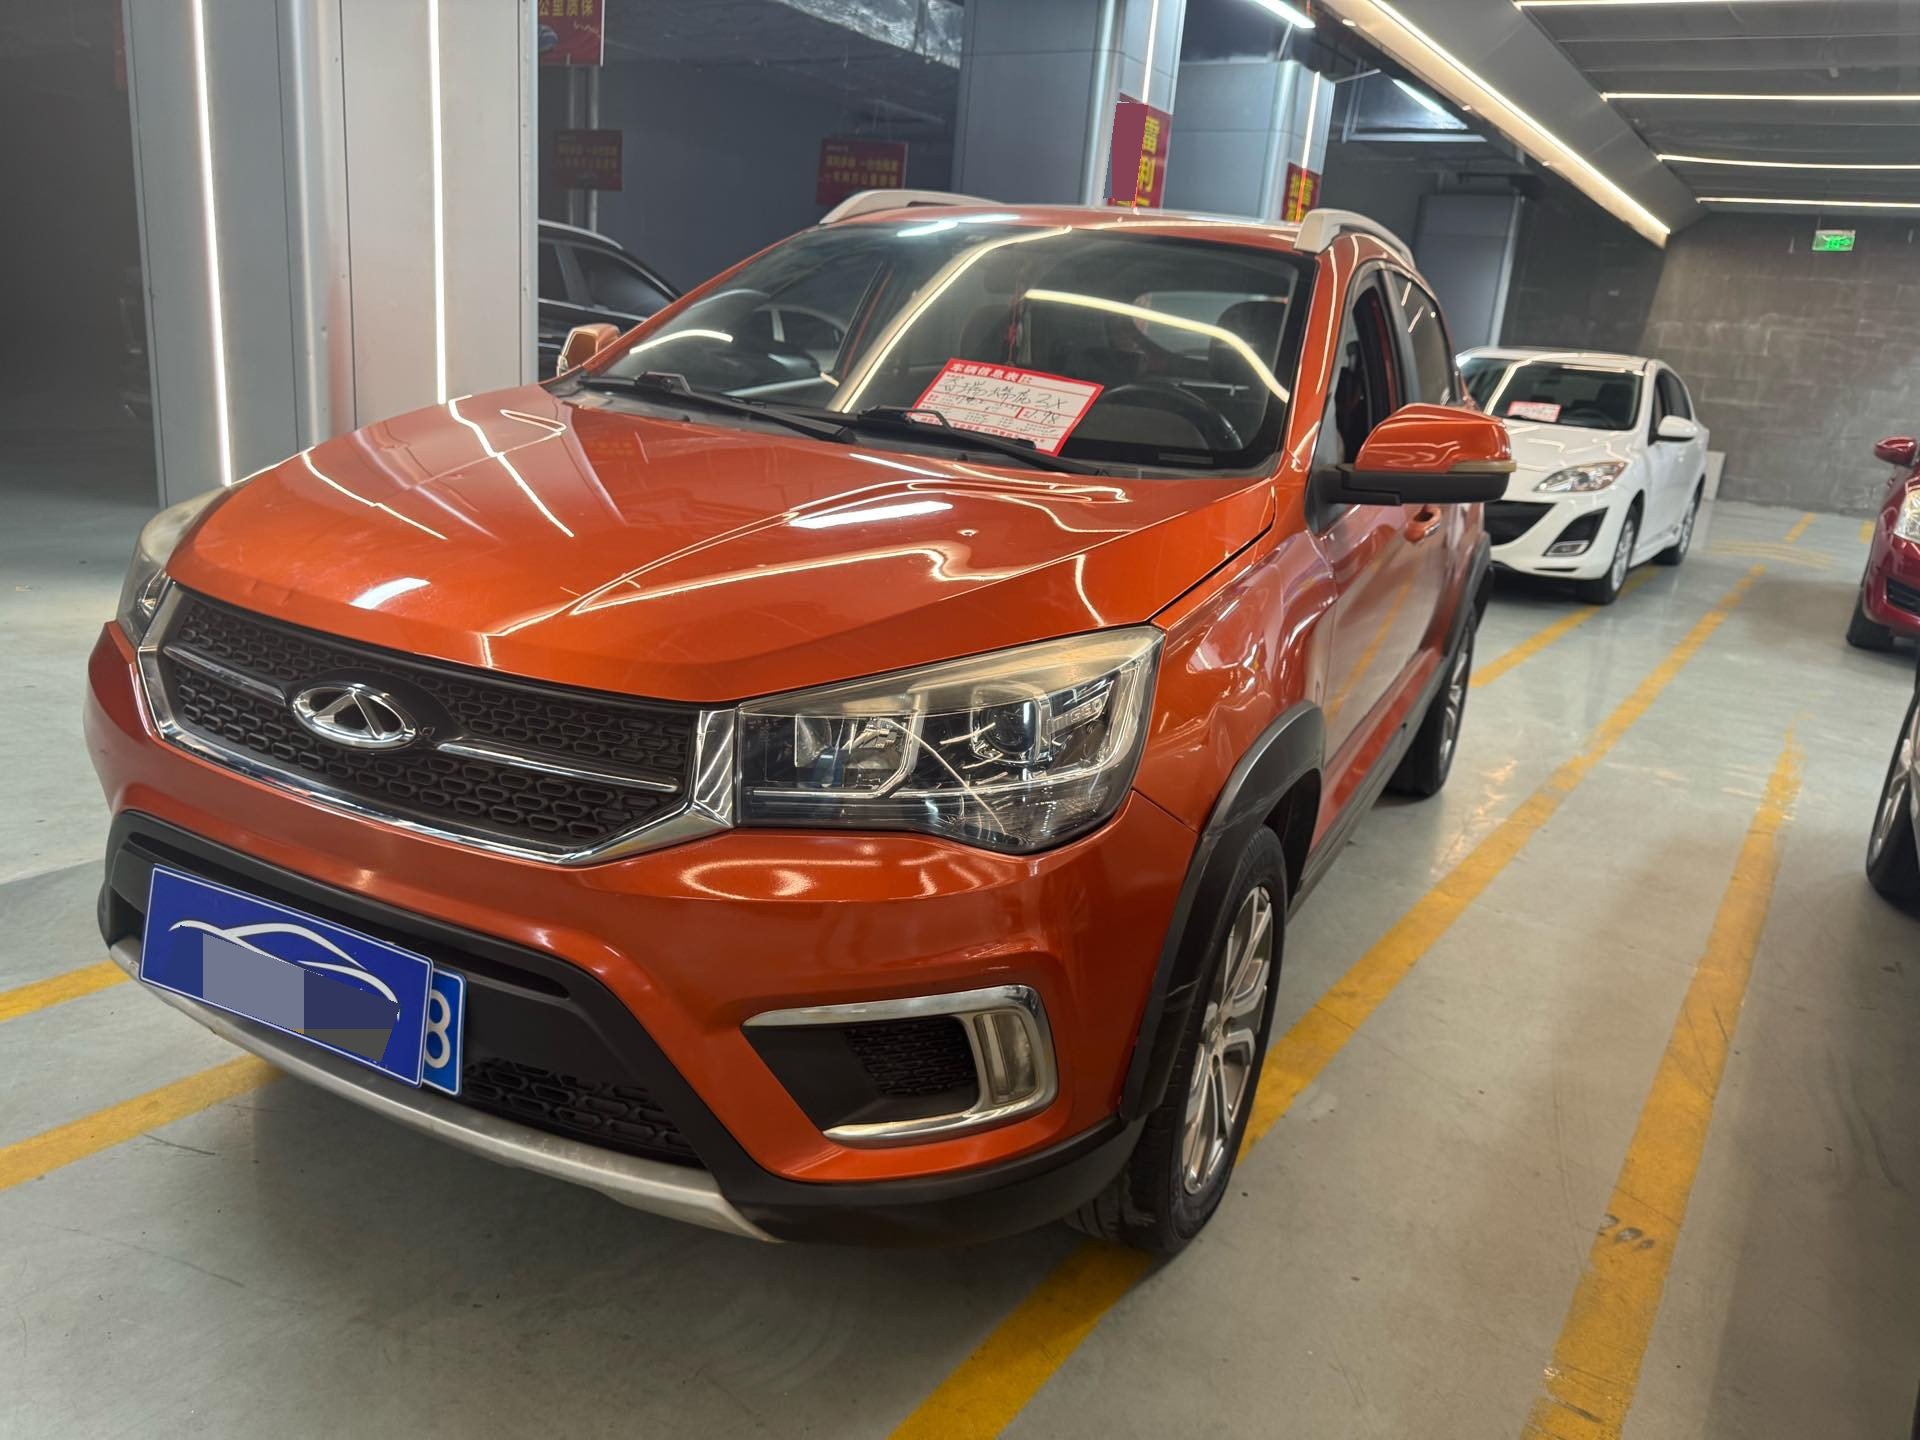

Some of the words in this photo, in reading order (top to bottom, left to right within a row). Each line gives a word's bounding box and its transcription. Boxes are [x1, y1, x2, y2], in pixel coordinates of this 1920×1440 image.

[949, 362, 1020, 383] 车辆信息表
